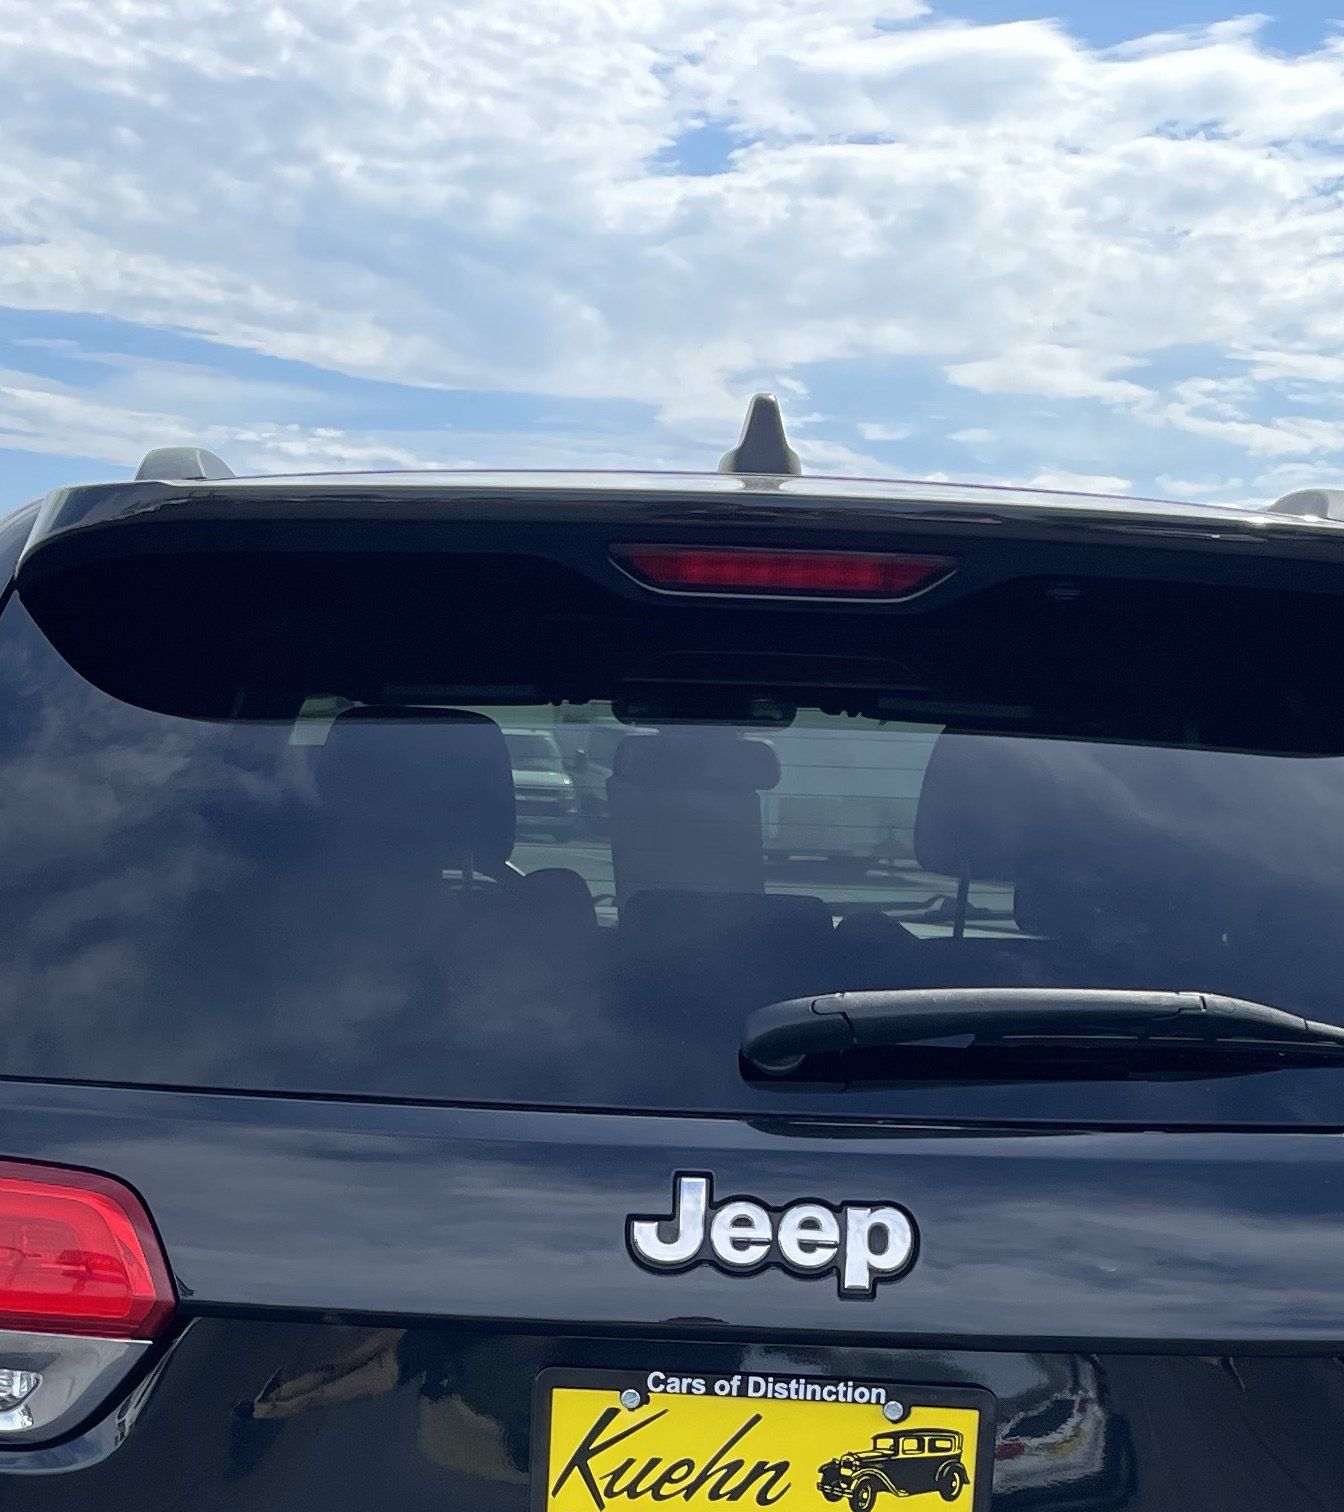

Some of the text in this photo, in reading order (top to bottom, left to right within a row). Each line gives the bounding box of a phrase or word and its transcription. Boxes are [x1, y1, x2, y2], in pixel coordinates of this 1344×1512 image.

[630, 1175, 914, 1292] Jeep
[646, 1371, 887, 1404] Cars of Distinction
[551, 1406, 792, 1511] Kuehn
